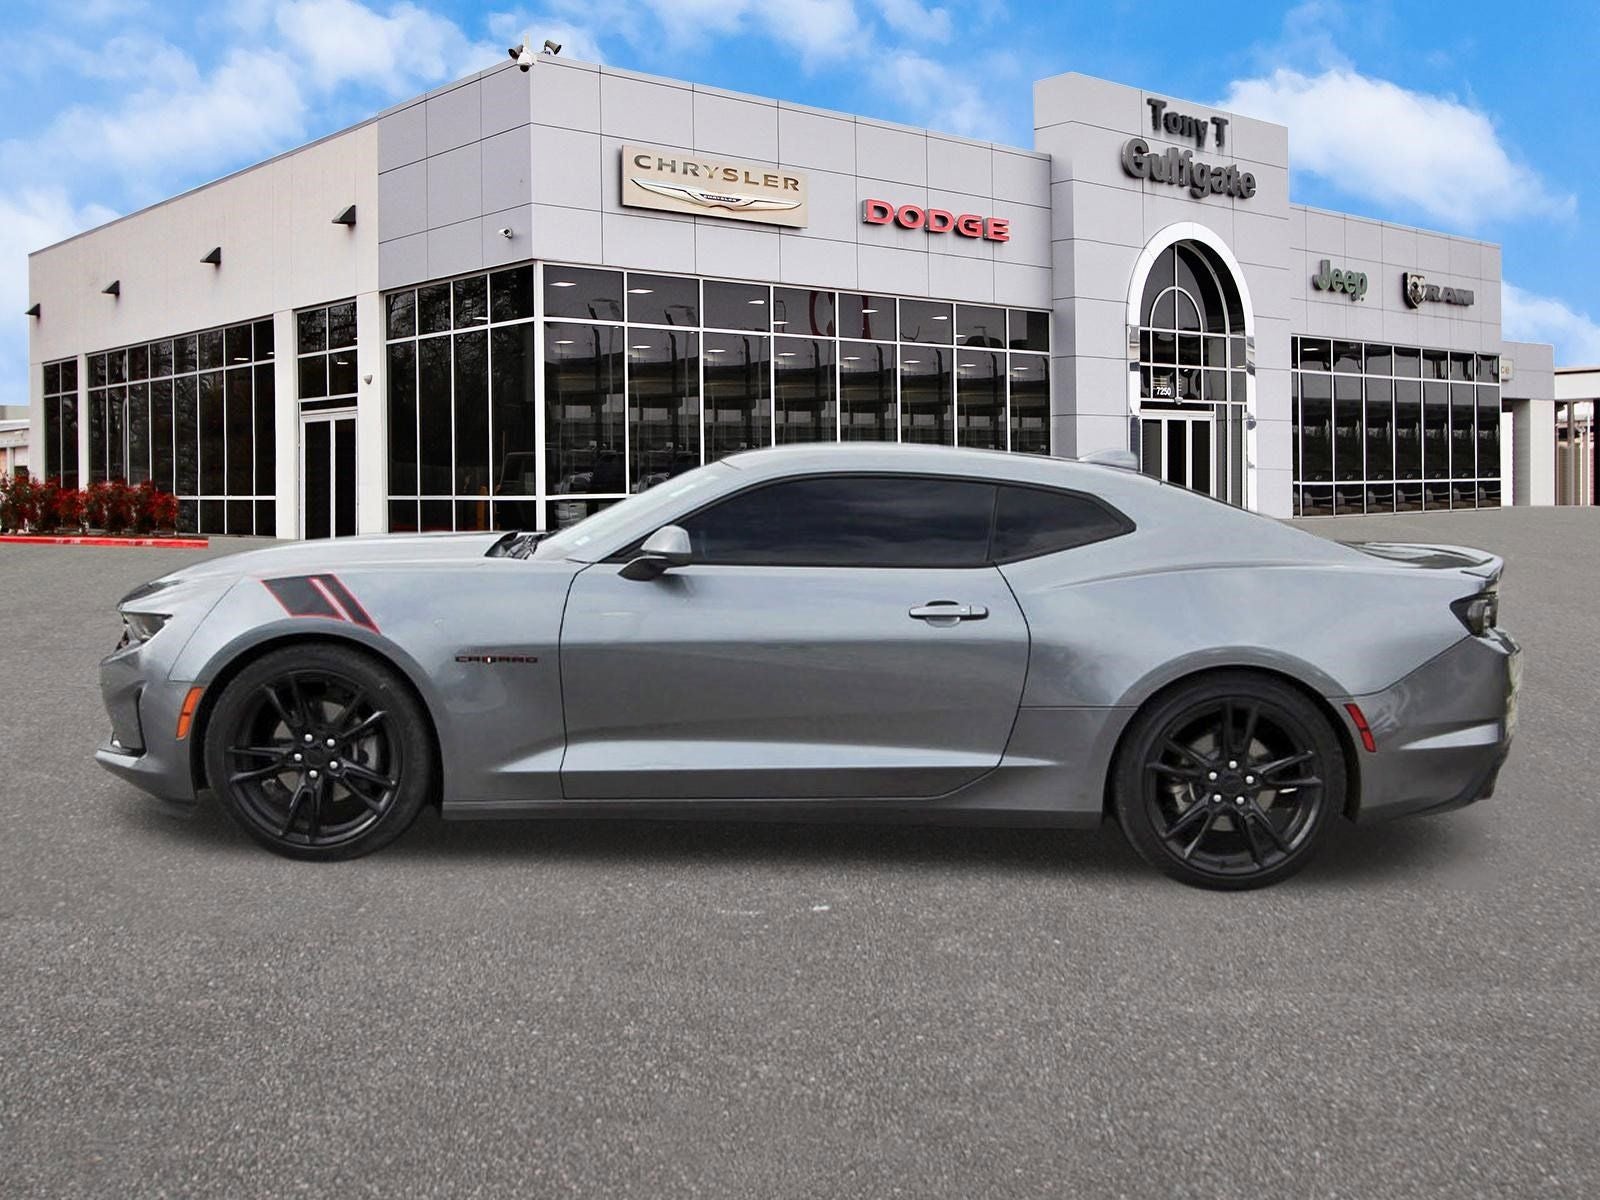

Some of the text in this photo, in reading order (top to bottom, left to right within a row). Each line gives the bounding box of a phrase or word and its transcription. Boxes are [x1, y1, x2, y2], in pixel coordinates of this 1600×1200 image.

[1147, 98, 1229, 147] Tony T
[633, 154, 800, 192] CHRYSLER
[1121, 138, 1257, 199] Gulfgate
[862, 199, 1010, 242] DODGE
[1312, 259, 1368, 302] Jeep
[1424, 284, 1475, 306] RAM
[1156, 386, 1172, 396] 7250
